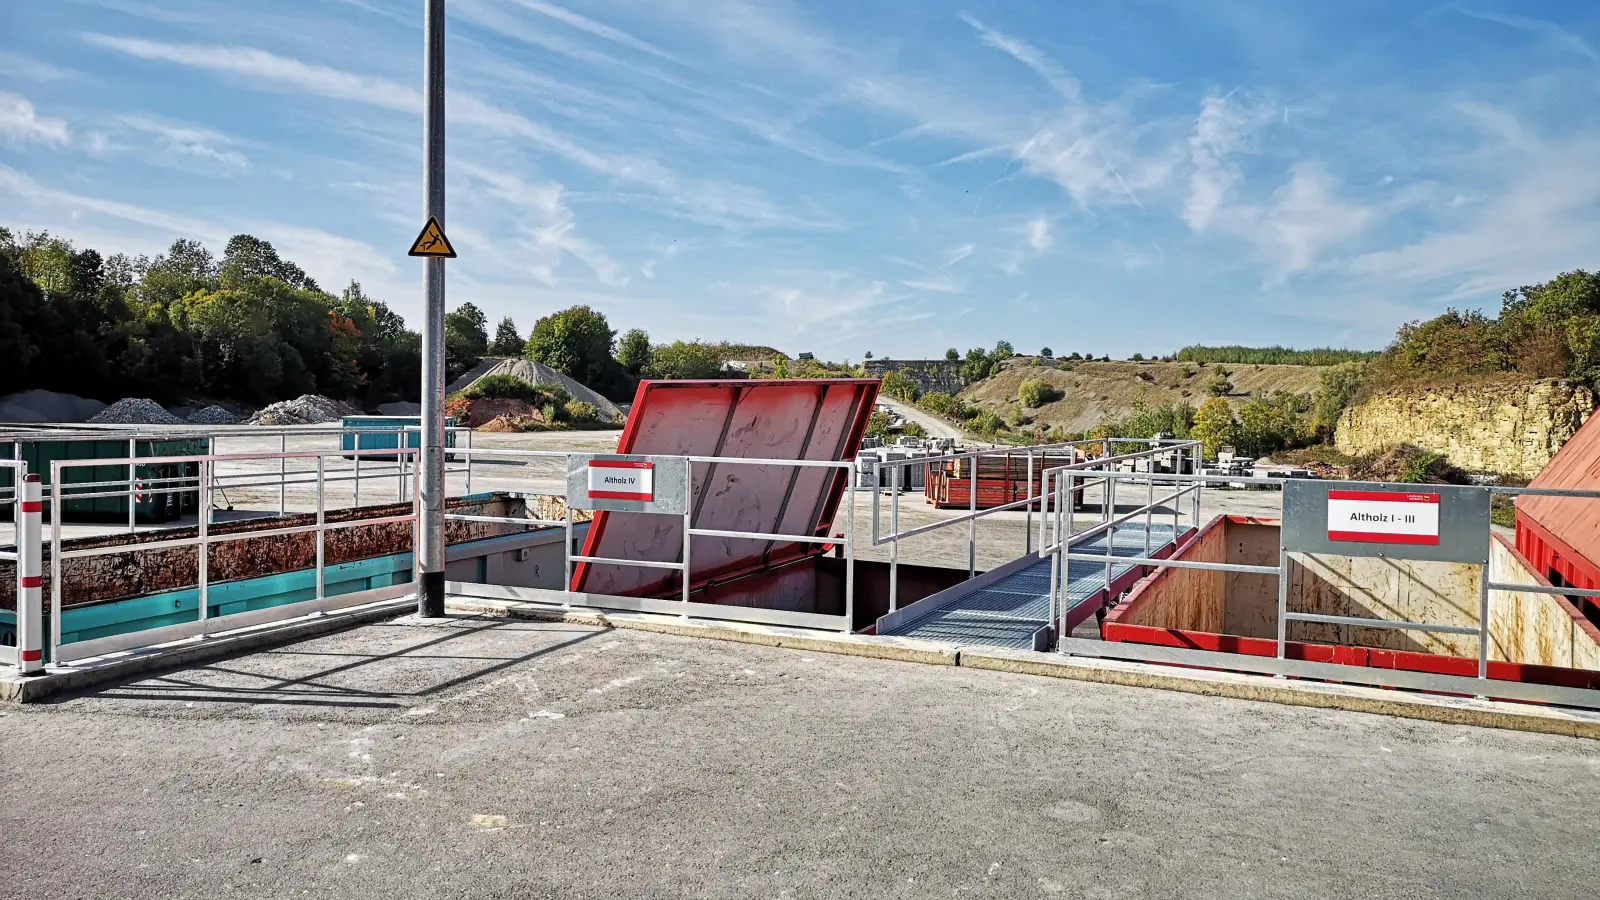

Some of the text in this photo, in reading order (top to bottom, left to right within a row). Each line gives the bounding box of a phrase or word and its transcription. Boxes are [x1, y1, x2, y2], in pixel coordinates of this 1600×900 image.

[604, 476, 627, 484] Altholz
[1350, 512, 1388, 522] Altholz
[1405, 514, 1415, 523] III
